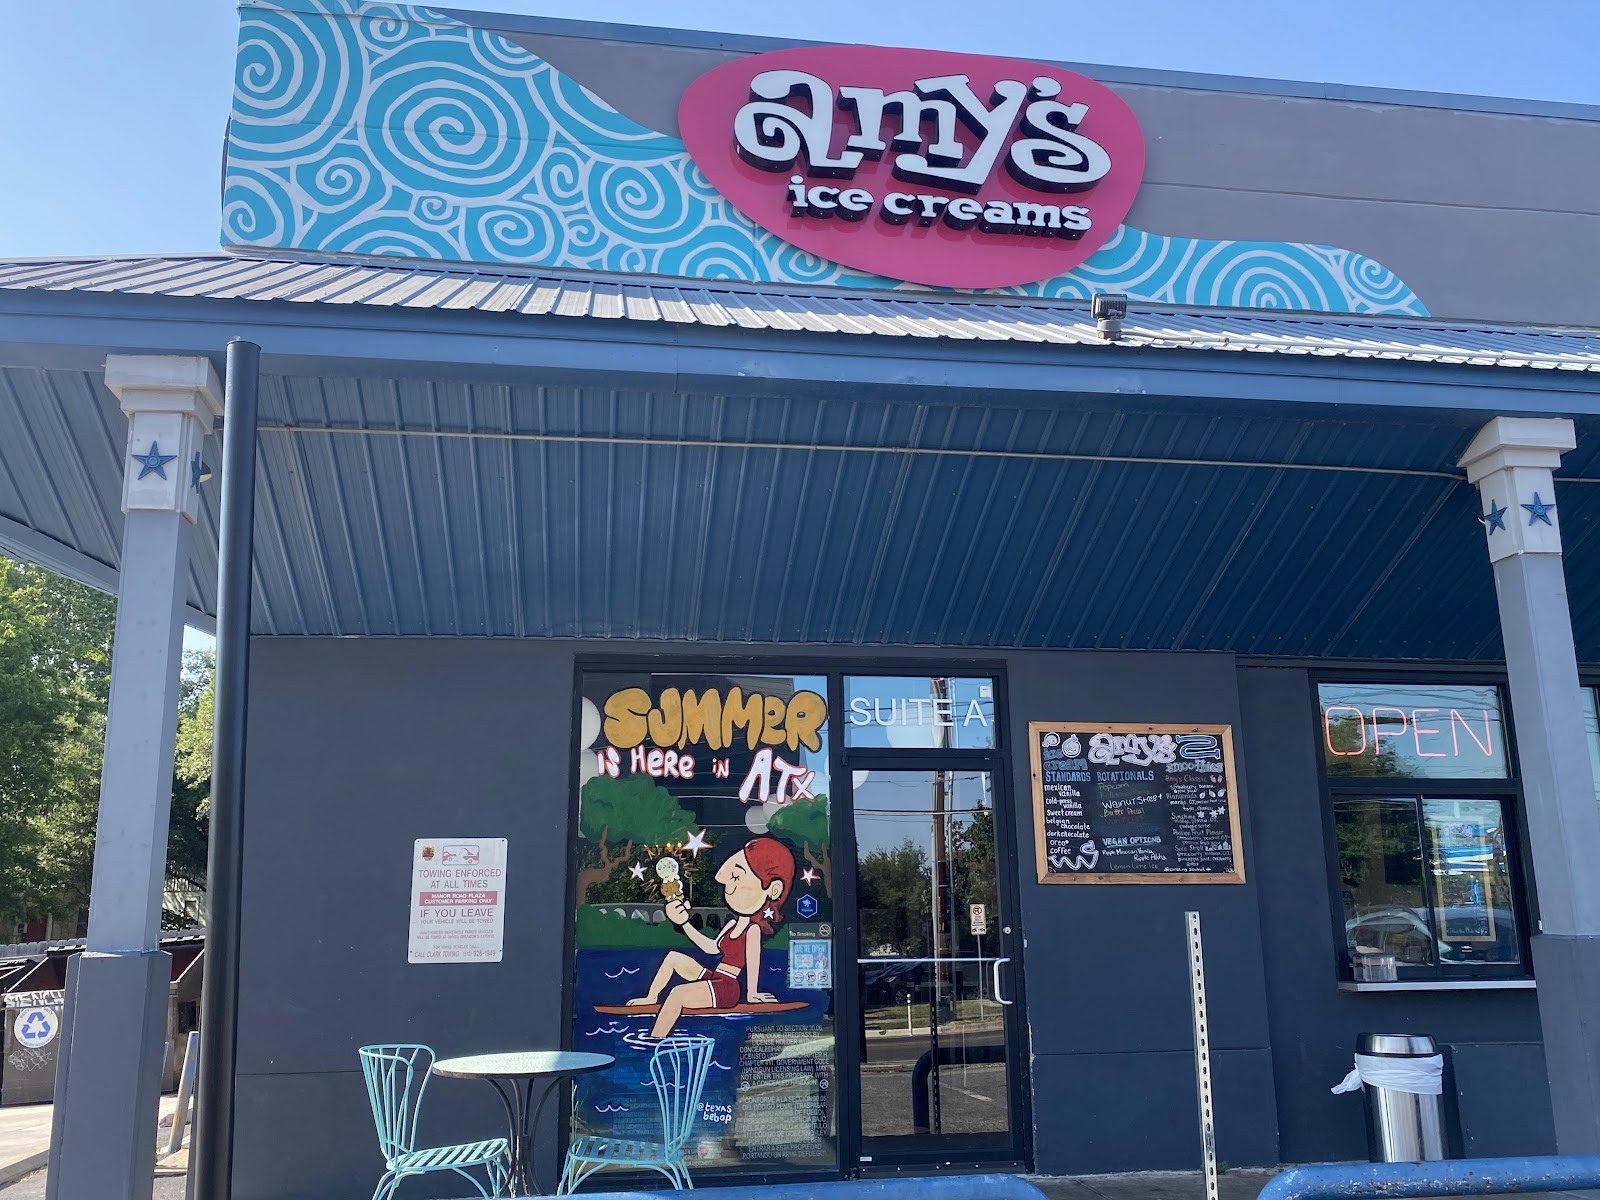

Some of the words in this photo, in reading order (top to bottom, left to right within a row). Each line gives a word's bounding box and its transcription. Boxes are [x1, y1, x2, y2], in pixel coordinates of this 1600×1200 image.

[733, 69, 1113, 194] amy's
[788, 175, 875, 217] ice
[883, 193, 1094, 236] creams
[850, 697, 954, 727] SUITE
[963, 699, 988, 727] A
[1325, 706, 1492, 757] OPEN
[1045, 771, 1091, 782] STANDARDS
[1096, 770, 1155, 782] ROTATIONALS
[1044, 783, 1072, 792] mexican
[1102, 837, 1128, 846] VEGAN
[1130, 836, 1162, 844] OPTIONS
[419, 870, 451, 878] TOWING
[456, 869, 501, 877] ENFORCED
[463, 880, 488, 888] TIMES
[434, 909, 456, 917] YOU
[461, 909, 494, 917] LEAVE
[703, 1111, 732, 1124] bebop
[742, 1152, 773, 1160] PORTANDO
